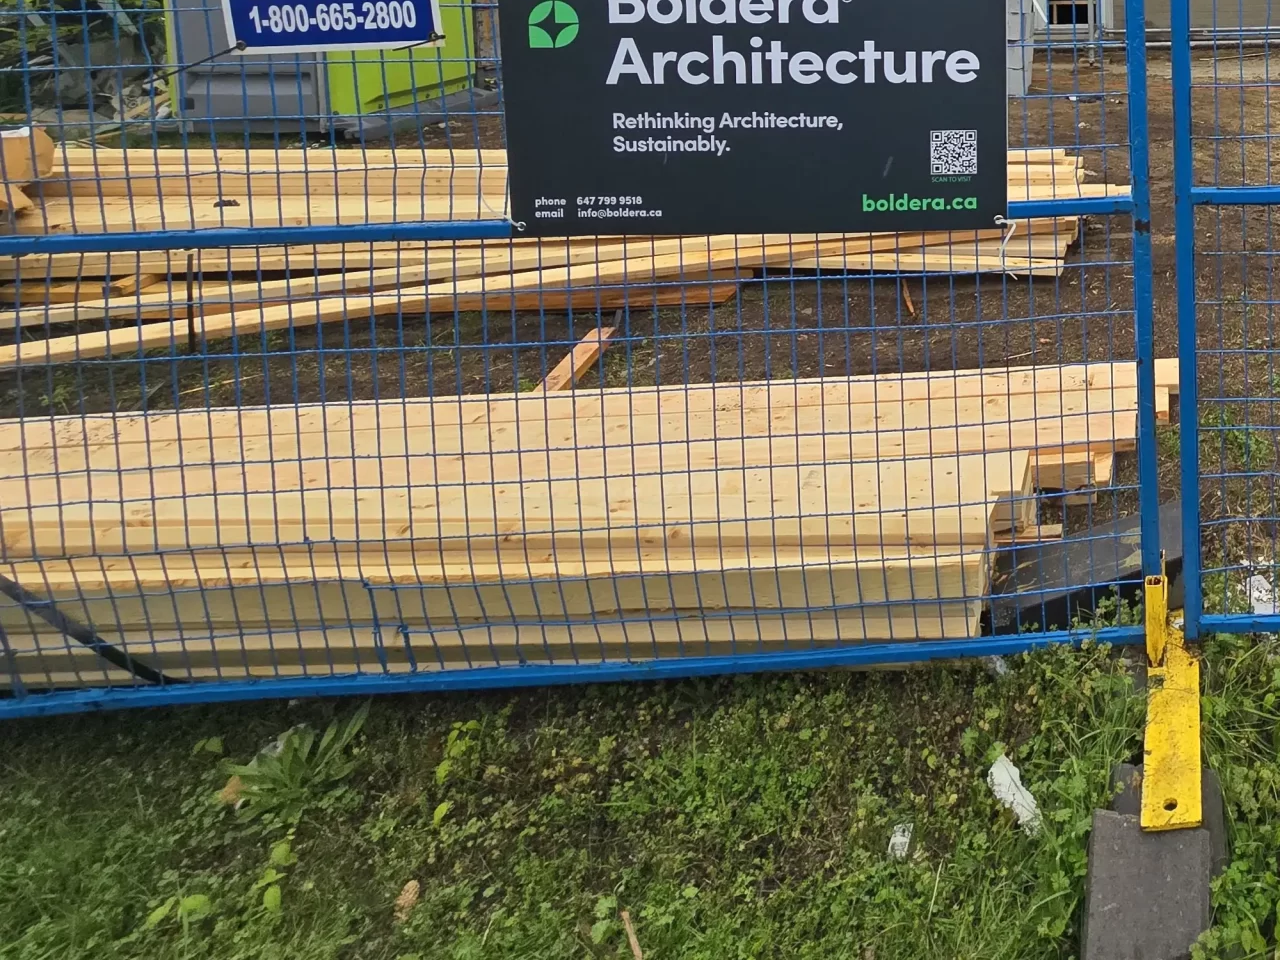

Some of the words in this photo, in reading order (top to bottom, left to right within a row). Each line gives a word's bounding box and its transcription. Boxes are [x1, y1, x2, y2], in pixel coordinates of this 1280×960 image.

[249, 0, 417, 33] 1-800-665-2800
[606, 35, 981, 85] Architecture
[612, 112, 715, 133] Rethinking
[718, 111, 844, 131] Architecture,
[612, 135, 731, 156] Sustainably.
[535, 197, 567, 208] phone
[576, 196, 596, 206] 647
[597, 196, 617, 205] 799
[619, 196, 643, 205] 9518
[862, 193, 978, 212] boldera.ca
[535, 208, 564, 218] email
[577, 208, 663, 219] info@boldera.ca
